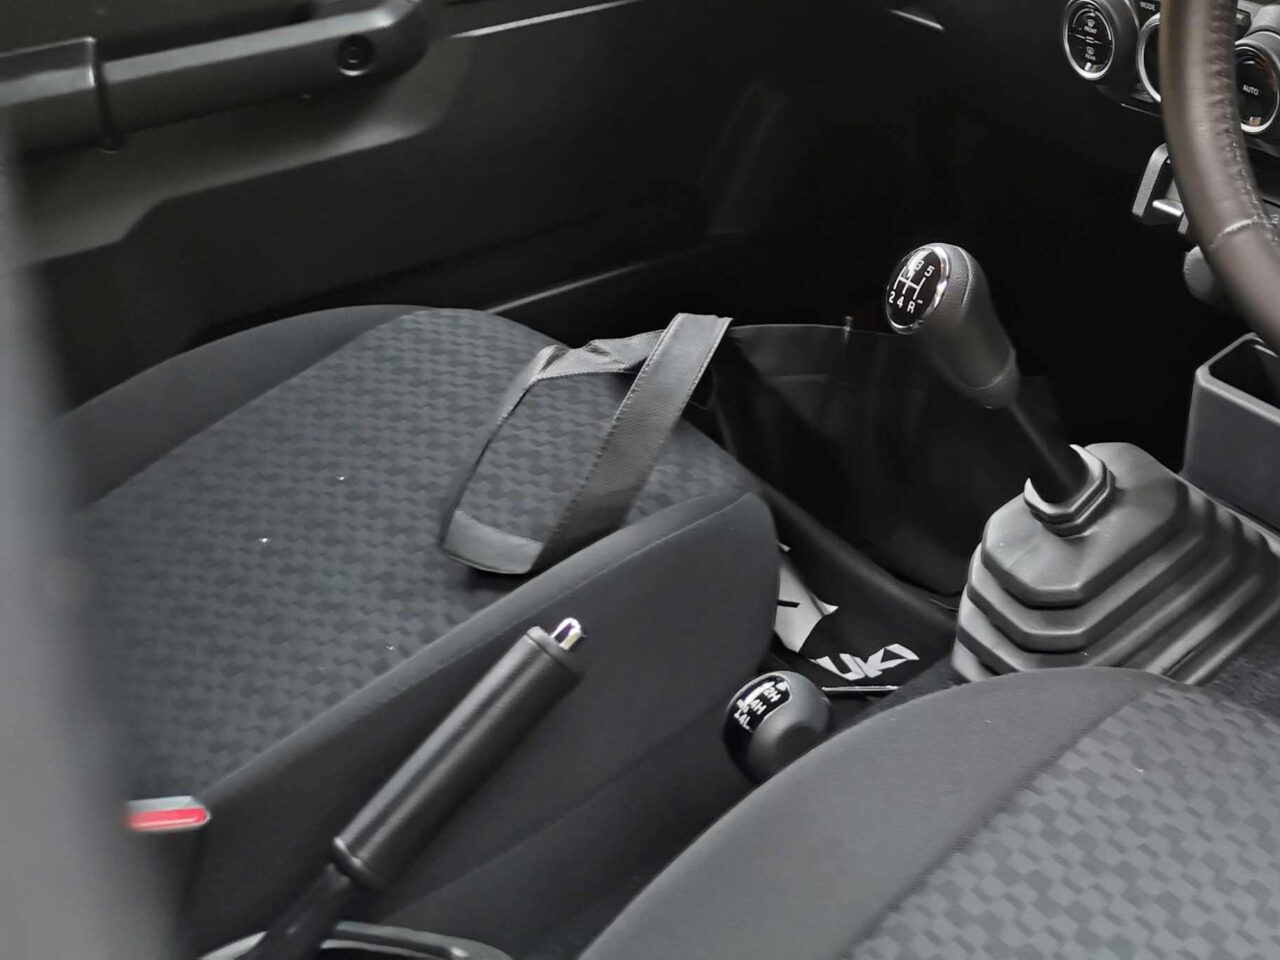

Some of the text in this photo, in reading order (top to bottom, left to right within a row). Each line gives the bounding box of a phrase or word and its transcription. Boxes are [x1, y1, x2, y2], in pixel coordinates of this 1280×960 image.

[1140, 1, 1156, 11] MODE
[1242, 84, 1259, 96] AUTO
[924, 265, 935, 277] 5
[889, 291, 916, 314] 2 4 R
[763, 686, 782, 702] 2H
[750, 699, 767, 715] 4H
